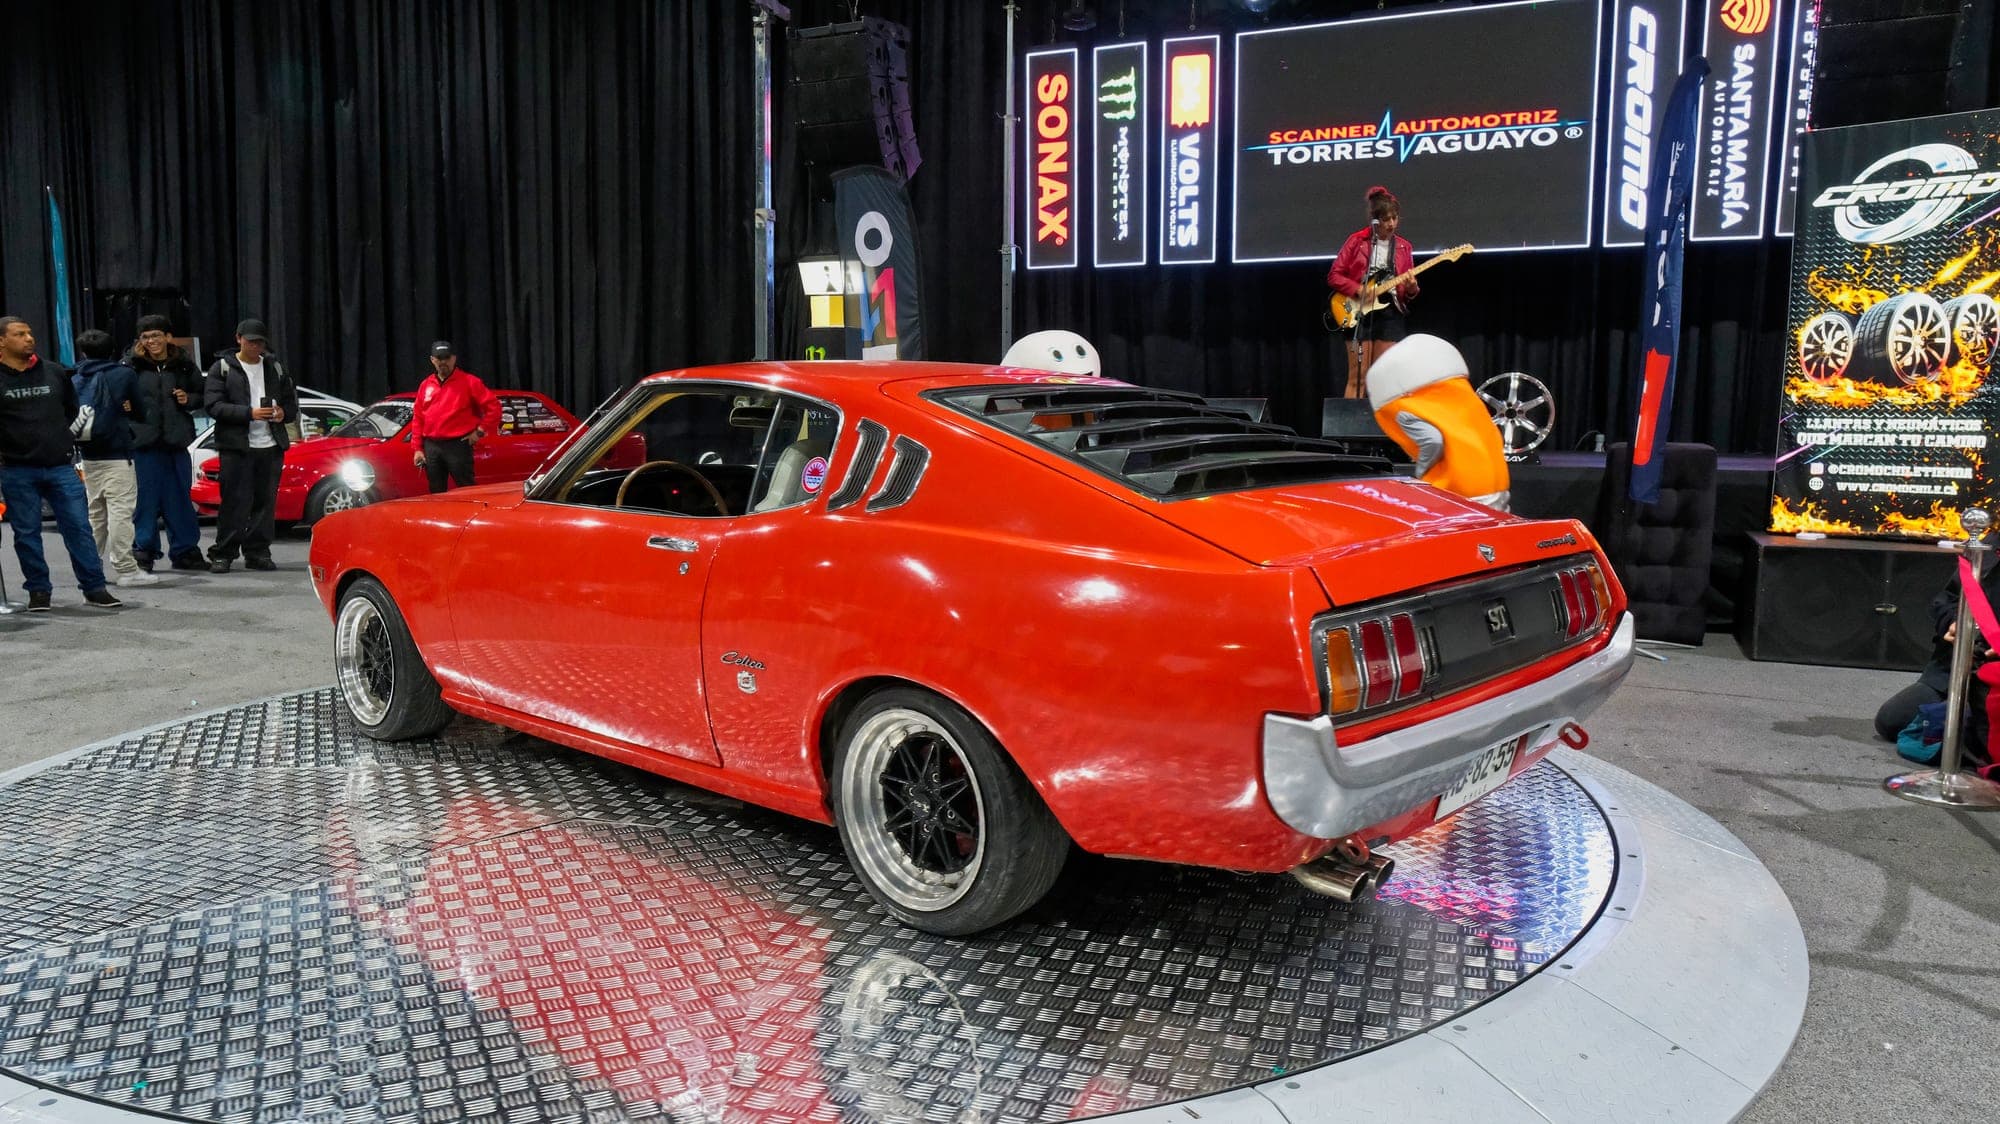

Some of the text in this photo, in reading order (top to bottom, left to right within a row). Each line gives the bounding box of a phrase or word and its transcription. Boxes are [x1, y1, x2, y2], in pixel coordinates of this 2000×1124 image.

[1269, 109, 1558, 145] SCANNER AUTOMOTRIZ
[1620, 6, 1657, 230] CROMO
[1720, 43, 1756, 229] SANTAMARÍA
[1268, 140, 1394, 165] TORRES
[1413, 128, 1558, 156] AGUAYO
[1706, 80, 1727, 196] AUTOMOTRIZ
[1118, 126, 1129, 241] MONSTER
[1177, 132, 1200, 247] VOLTS
[1812, 172, 2000, 208] CROMO
[1169, 208, 1177, 247] VOLTAJE
[1796, 432, 1987, 448] QUE MARCAN TU CAMINO
[1806, 416, 1982, 431] LLANTAS Y NEUMÁTICOS
[1488, 605, 1508, 632] ST
[721, 651, 767, 670] Celica
